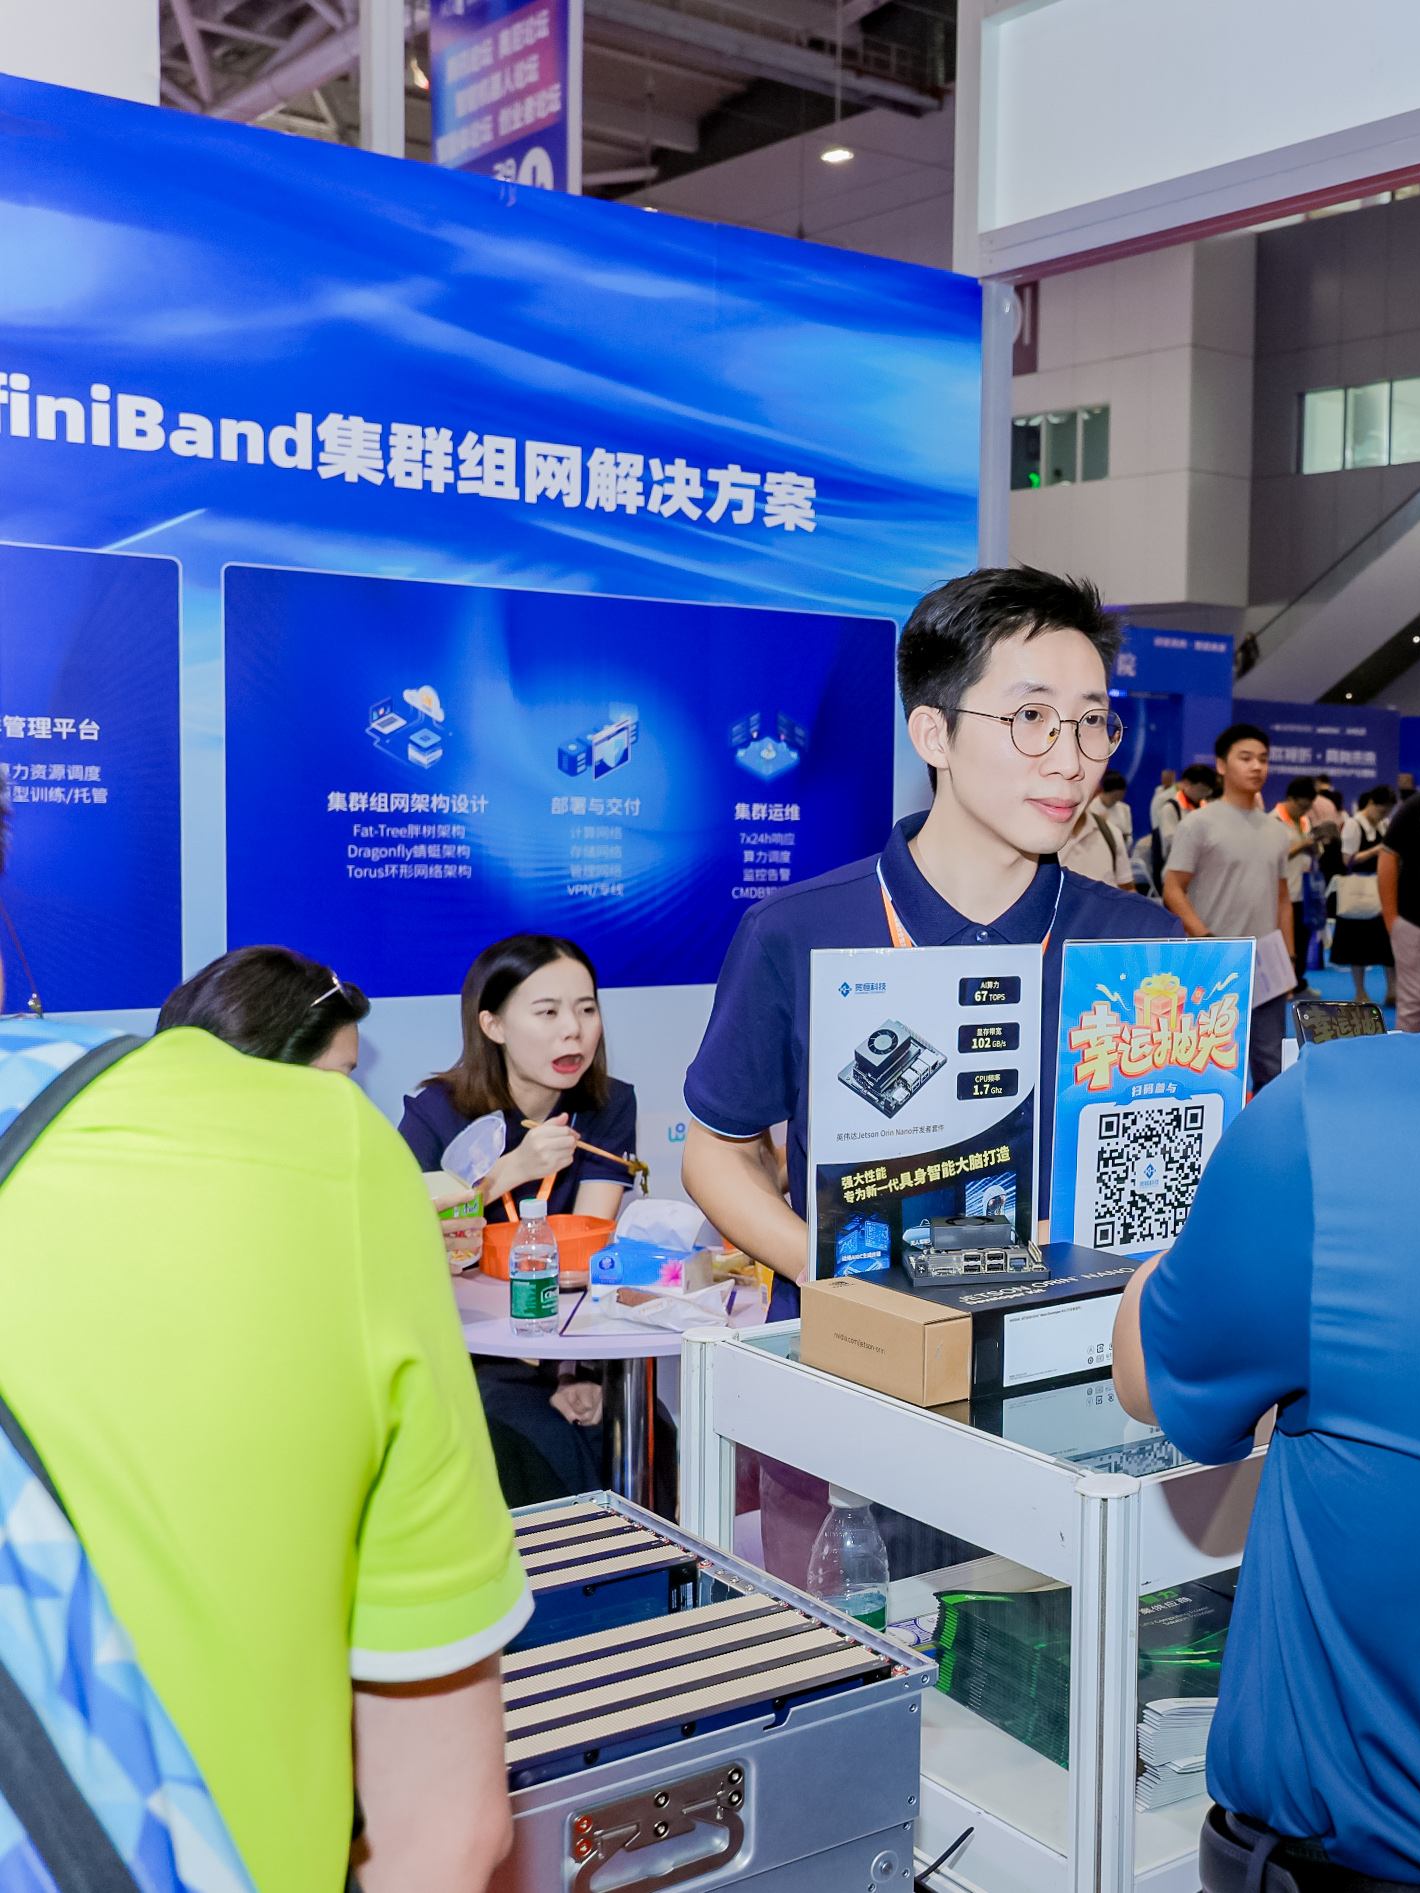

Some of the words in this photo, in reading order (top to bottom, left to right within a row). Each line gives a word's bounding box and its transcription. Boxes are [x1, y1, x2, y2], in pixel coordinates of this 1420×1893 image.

[3, 714, 101, 741] 管理平台
[327, 790, 489, 814] 集群组网架构设计
[551, 796, 641, 816] 部署与交付
[735, 802, 801, 822] 集群运维
[353, 823, 466, 840] Fat-Tree胖树架构
[346, 864, 472, 879] Torus环形网络架构
[974, 990, 988, 1002] 67
[989, 993, 1006, 1002] TOPS
[971, 1037, 991, 1050] 102
[992, 1040, 1007, 1049] GB/s
[1070, 995, 1240, 1091] 幸运抽奖
[972, 1083, 990, 1096] 1.7
[990, 1086, 1003, 1095] Ghz
[840, 1166, 888, 1191] 强大性能
[843, 1144, 1012, 1205] 专为新一代具身智能大脑打造
[959, 1285, 1032, 1303] JETSON
[1031, 1276, 1079, 1289] ORIN
[1081, 1266, 1136, 1281] NANO
